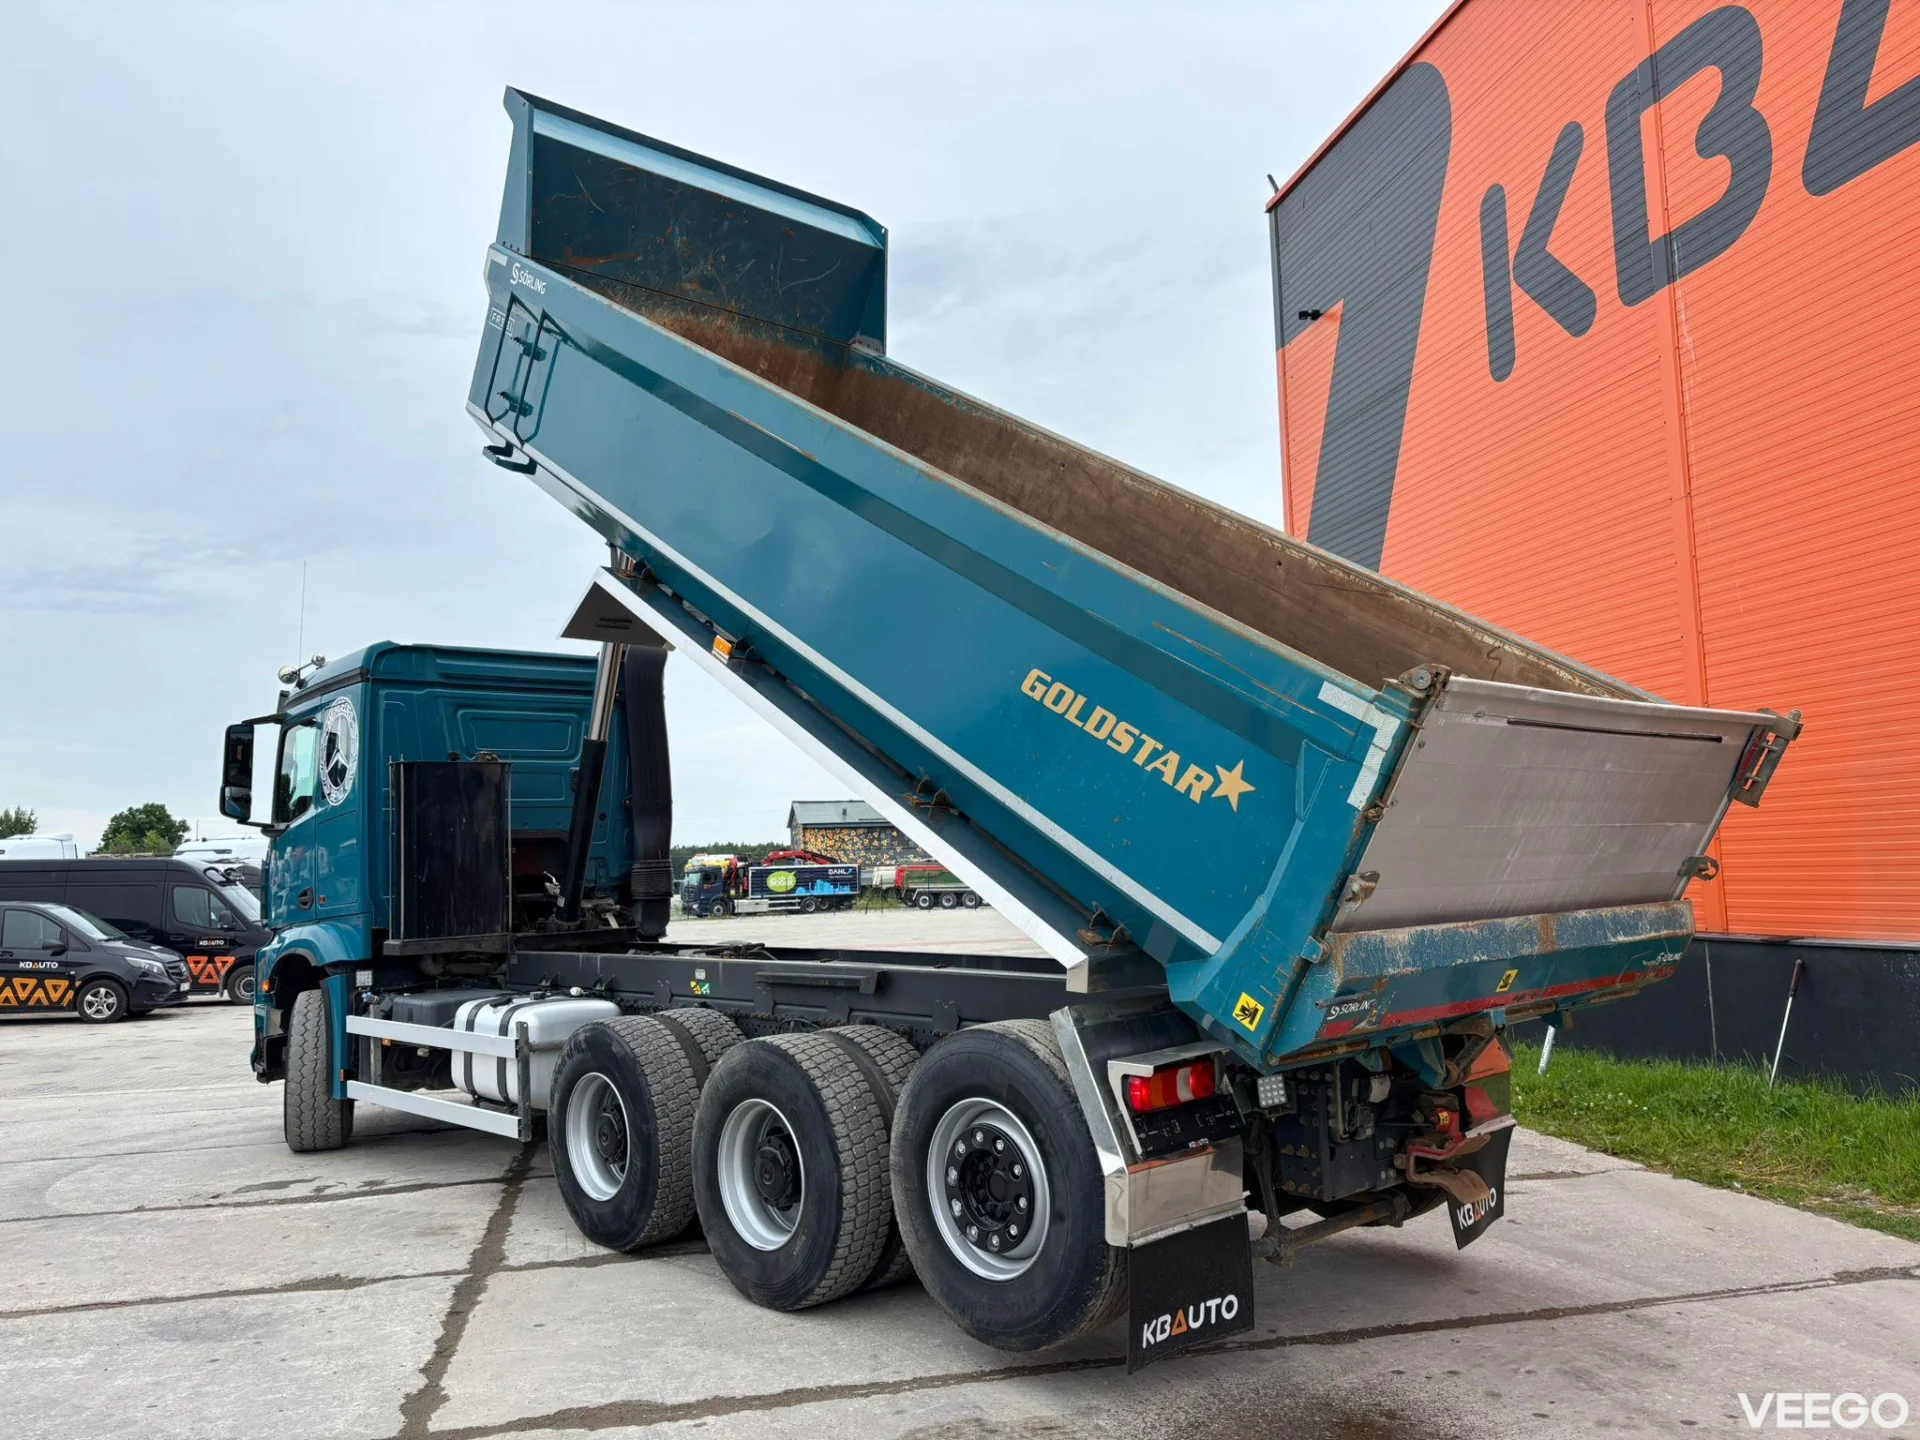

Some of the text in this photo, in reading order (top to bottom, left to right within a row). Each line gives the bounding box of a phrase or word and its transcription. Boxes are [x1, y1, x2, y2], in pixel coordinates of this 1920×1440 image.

[1021, 668, 1215, 804] GOLDSTAR
[19, 961, 59, 969] KBAUTO
[1142, 1294, 1239, 1349] KBAUTO
